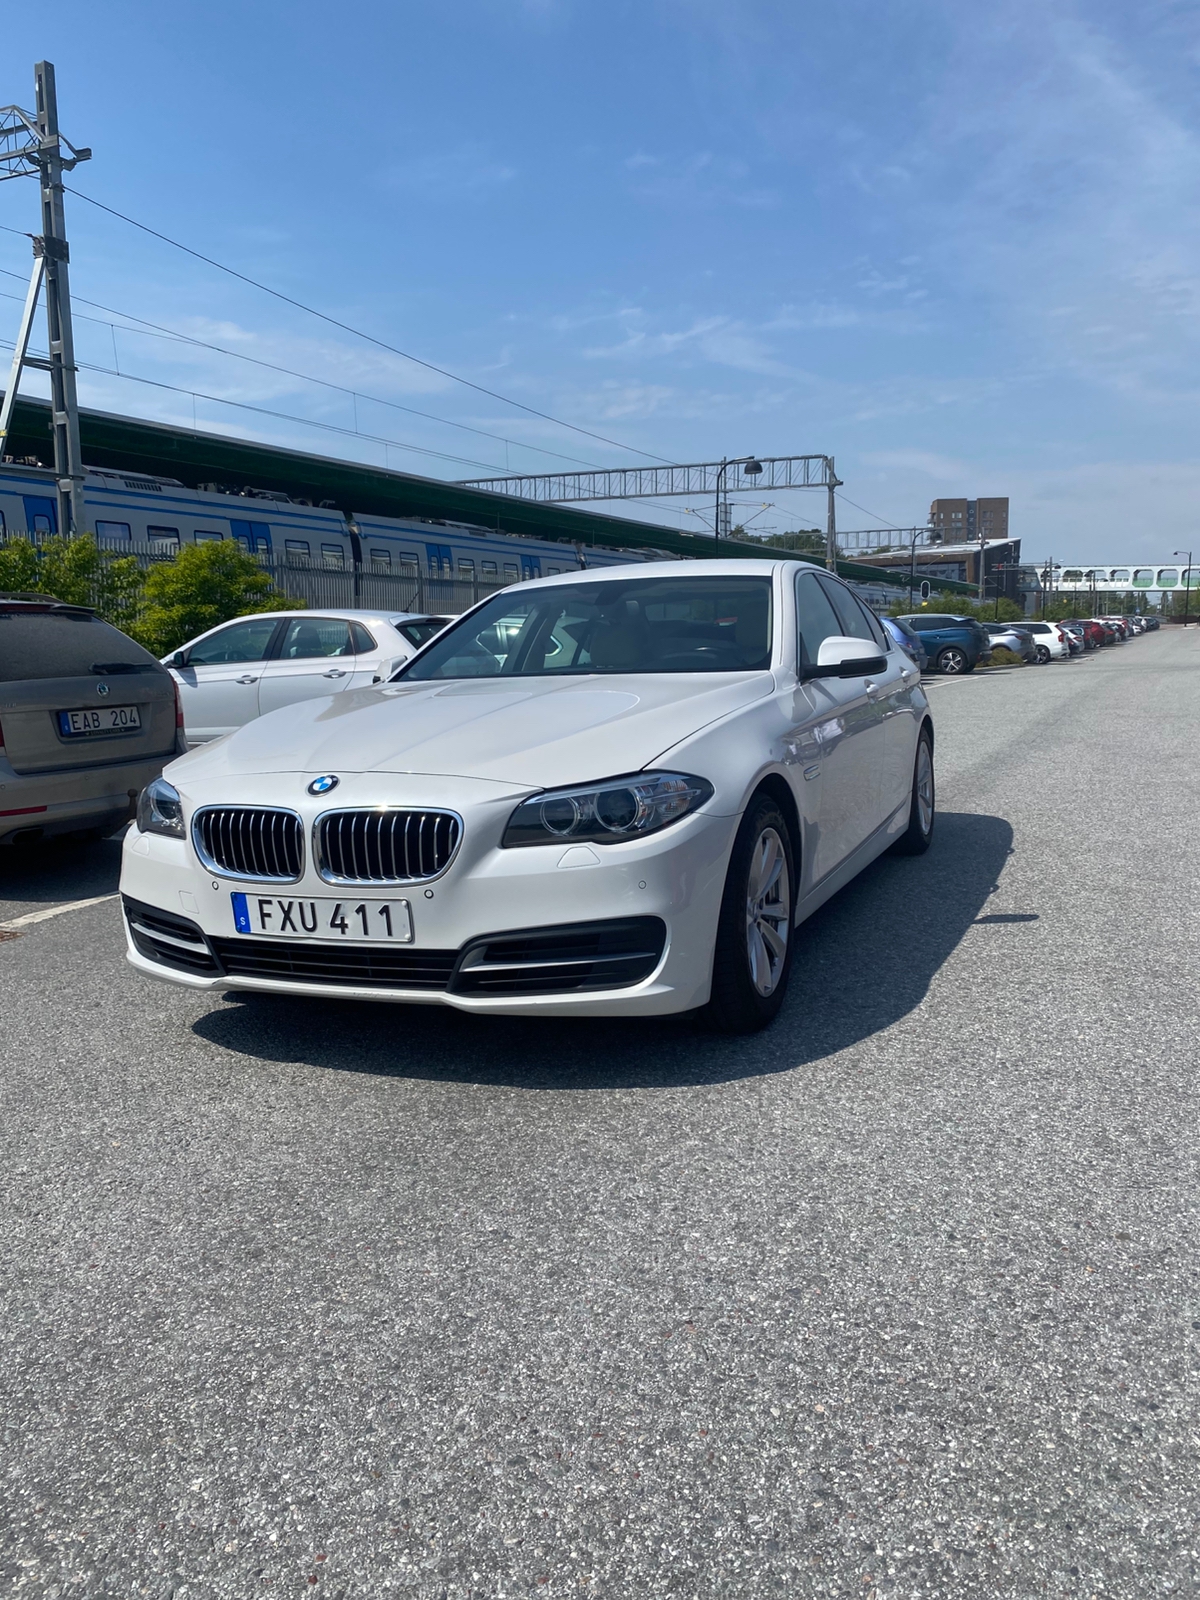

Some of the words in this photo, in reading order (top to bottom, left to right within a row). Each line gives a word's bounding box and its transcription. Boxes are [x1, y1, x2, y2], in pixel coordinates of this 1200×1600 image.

[71, 712, 101, 731] EAB
[111, 709, 137, 726] 204
[240, 917, 246, 925] S
[258, 899, 318, 932] FXU
[330, 903, 393, 936] 411
